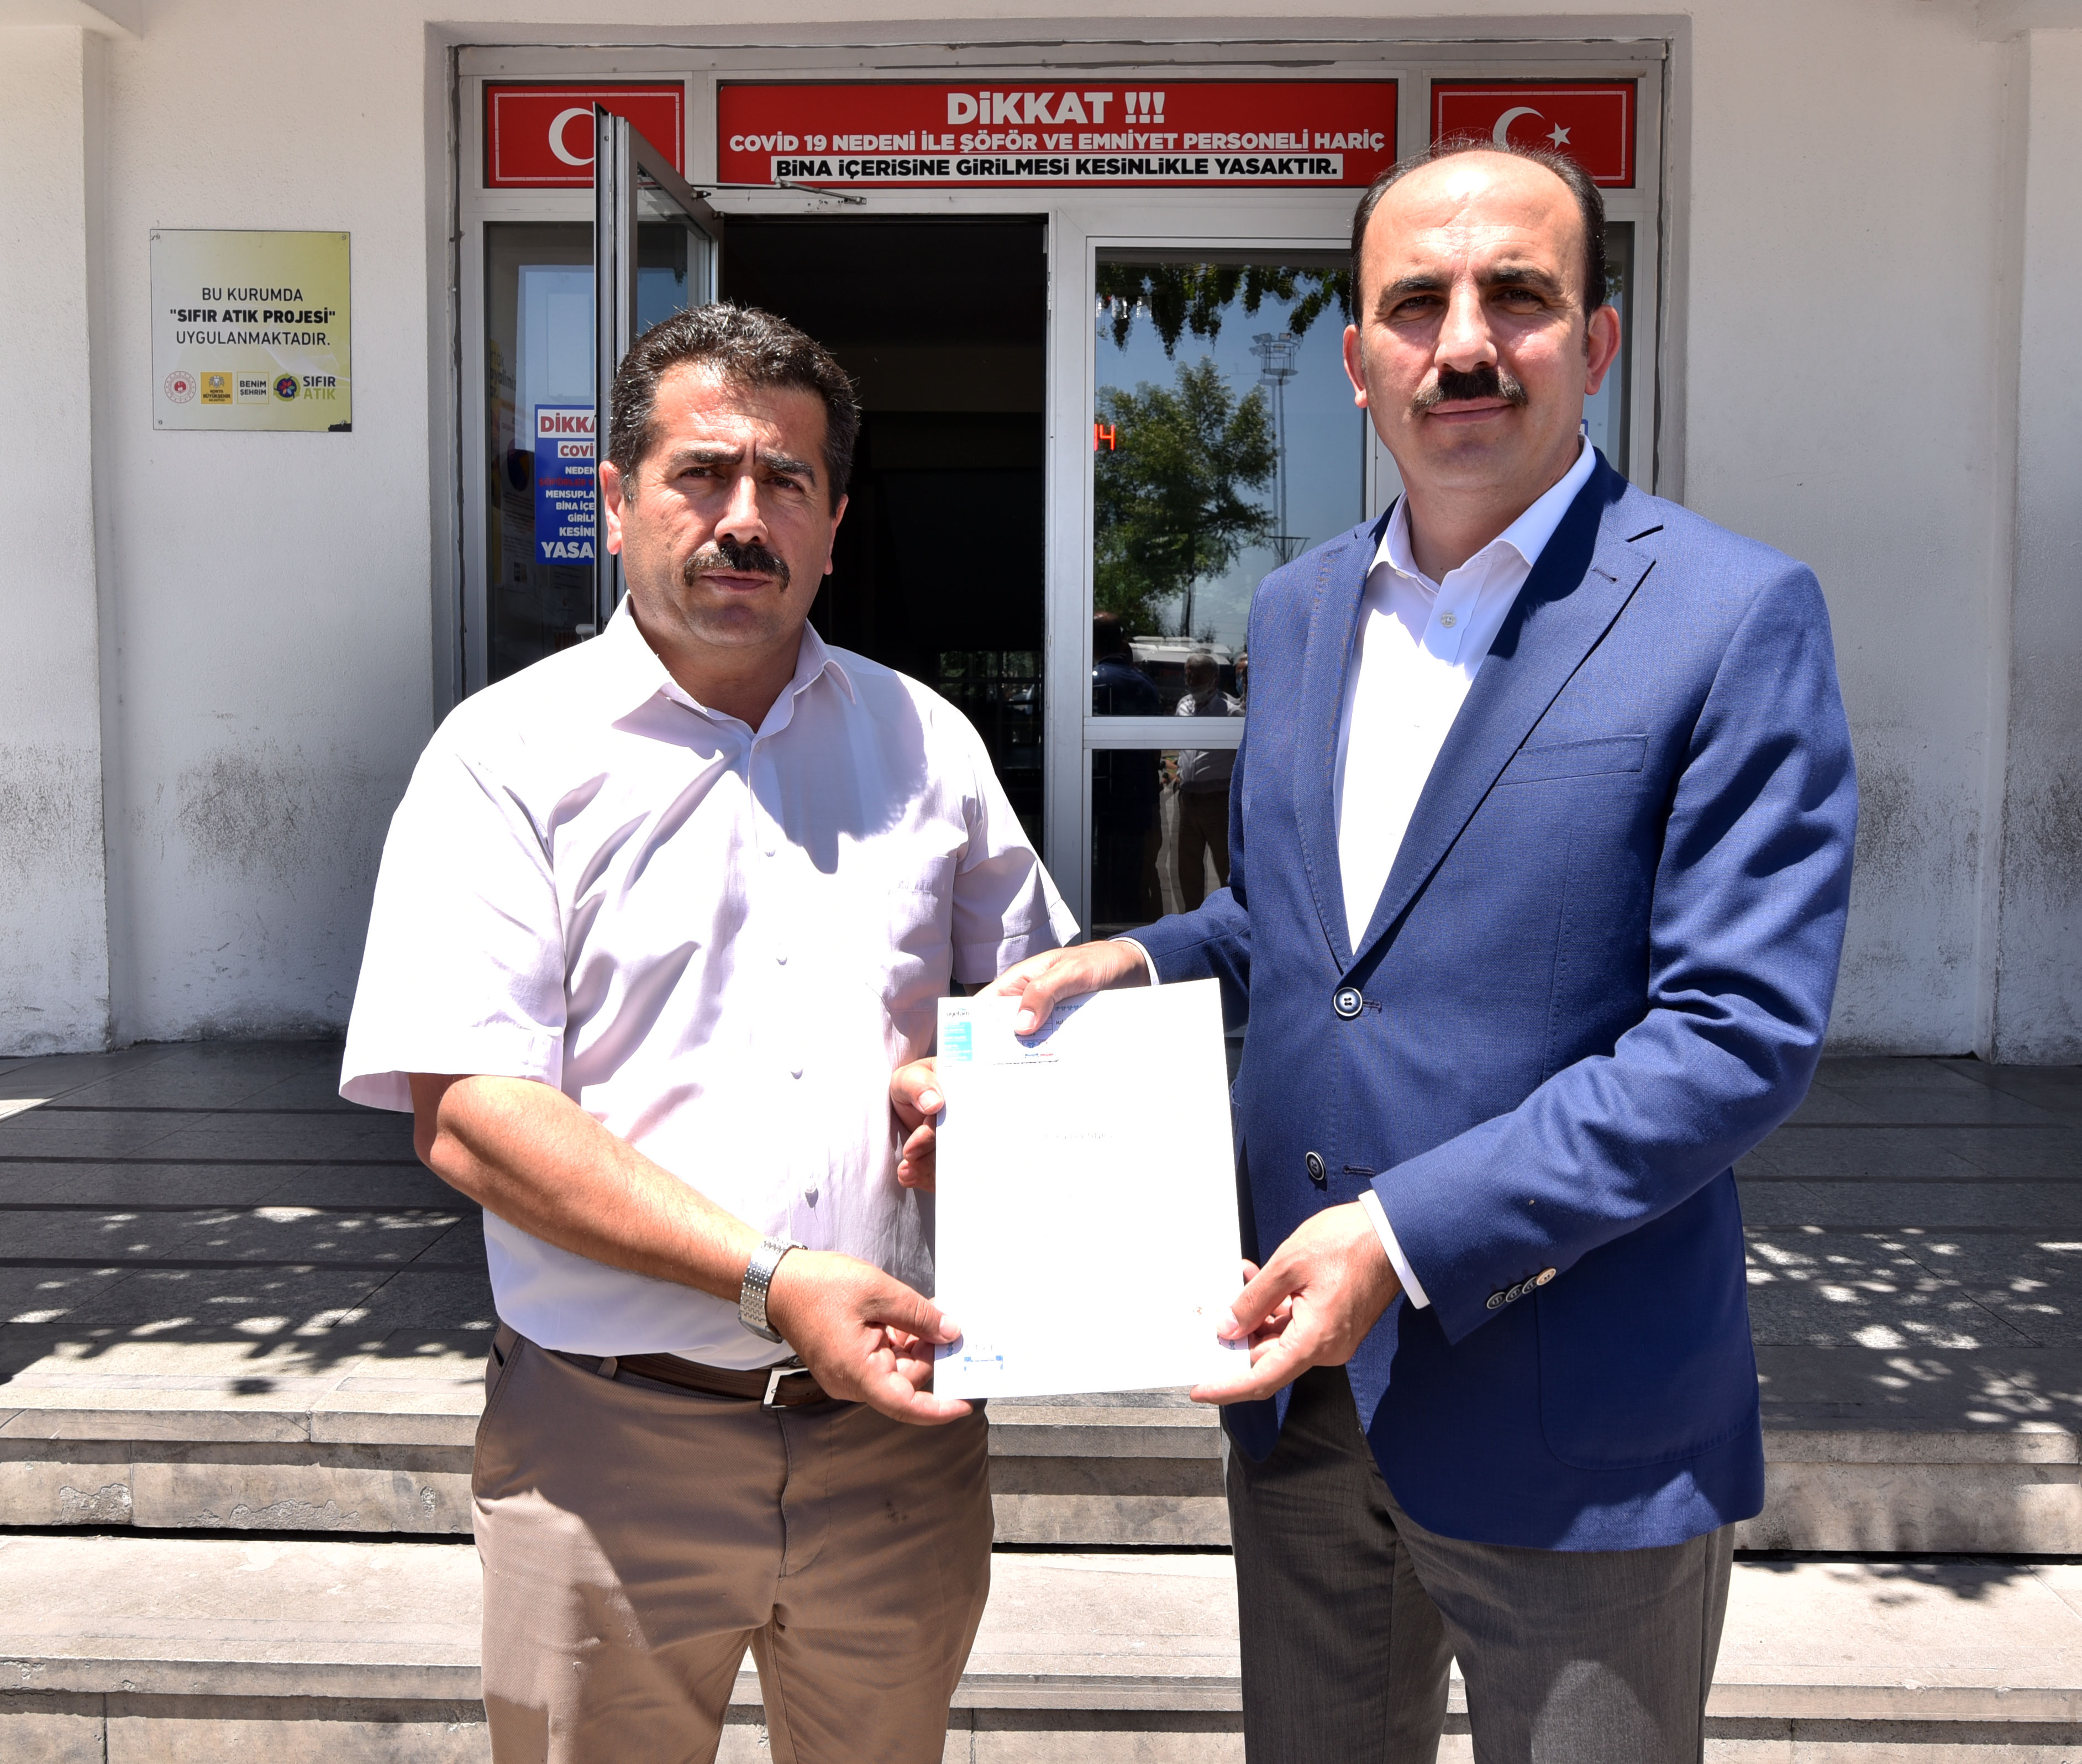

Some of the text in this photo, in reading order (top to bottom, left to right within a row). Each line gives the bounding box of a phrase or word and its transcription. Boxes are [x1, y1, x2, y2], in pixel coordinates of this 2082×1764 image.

[1125, 92, 1165, 123] !!!
[803, 134, 827, 151] 19
[960, 129, 1037, 153] ŞÖFÖR
[1042, 133, 1073, 150] VE
[1214, 158, 1337, 175] YASAKTIR.
[202, 287, 303, 302] BU KURUMDA
[170, 309, 217, 323] "SIFIR
[222, 309, 259, 323] ATIK
[176, 331, 330, 346] UYGULANMAKTADIR.
[303, 376, 336, 387] SIFIR
[303, 388, 336, 400] ATIK
[560, 443, 594, 457] COVİ
[565, 466, 595, 475] NEDEN
[546, 490, 595, 498] MENSUPLA
[580, 501, 595, 512] İÇE
[559, 525, 595, 537] KESİNL
[541, 542, 594, 559] YASA
